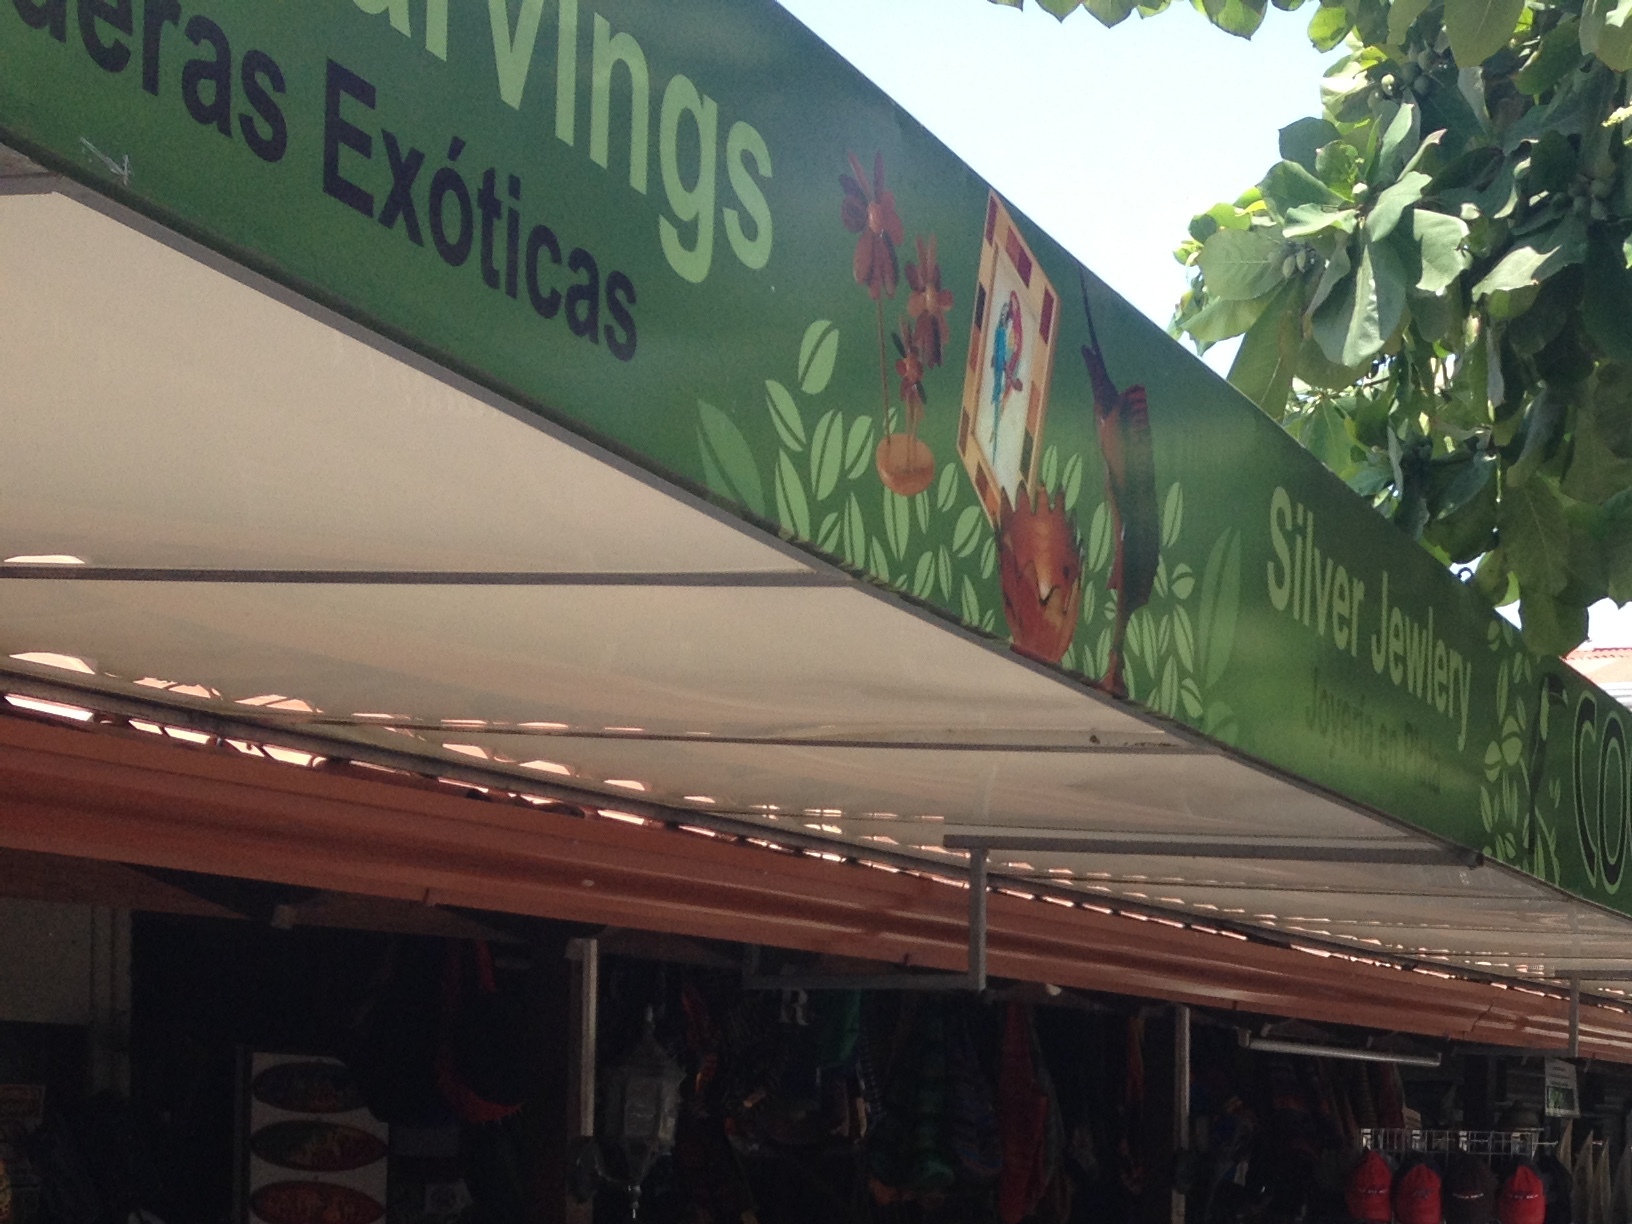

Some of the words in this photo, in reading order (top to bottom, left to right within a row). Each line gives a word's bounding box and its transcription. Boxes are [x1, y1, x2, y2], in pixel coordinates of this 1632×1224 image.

[8, 0, 289, 163] eras
[322, 58, 639, 362] Exóticas
[352, 0, 773, 284] vings
[1267, 486, 1365, 658] Silver
[1370, 570, 1473, 752] Jewlery
